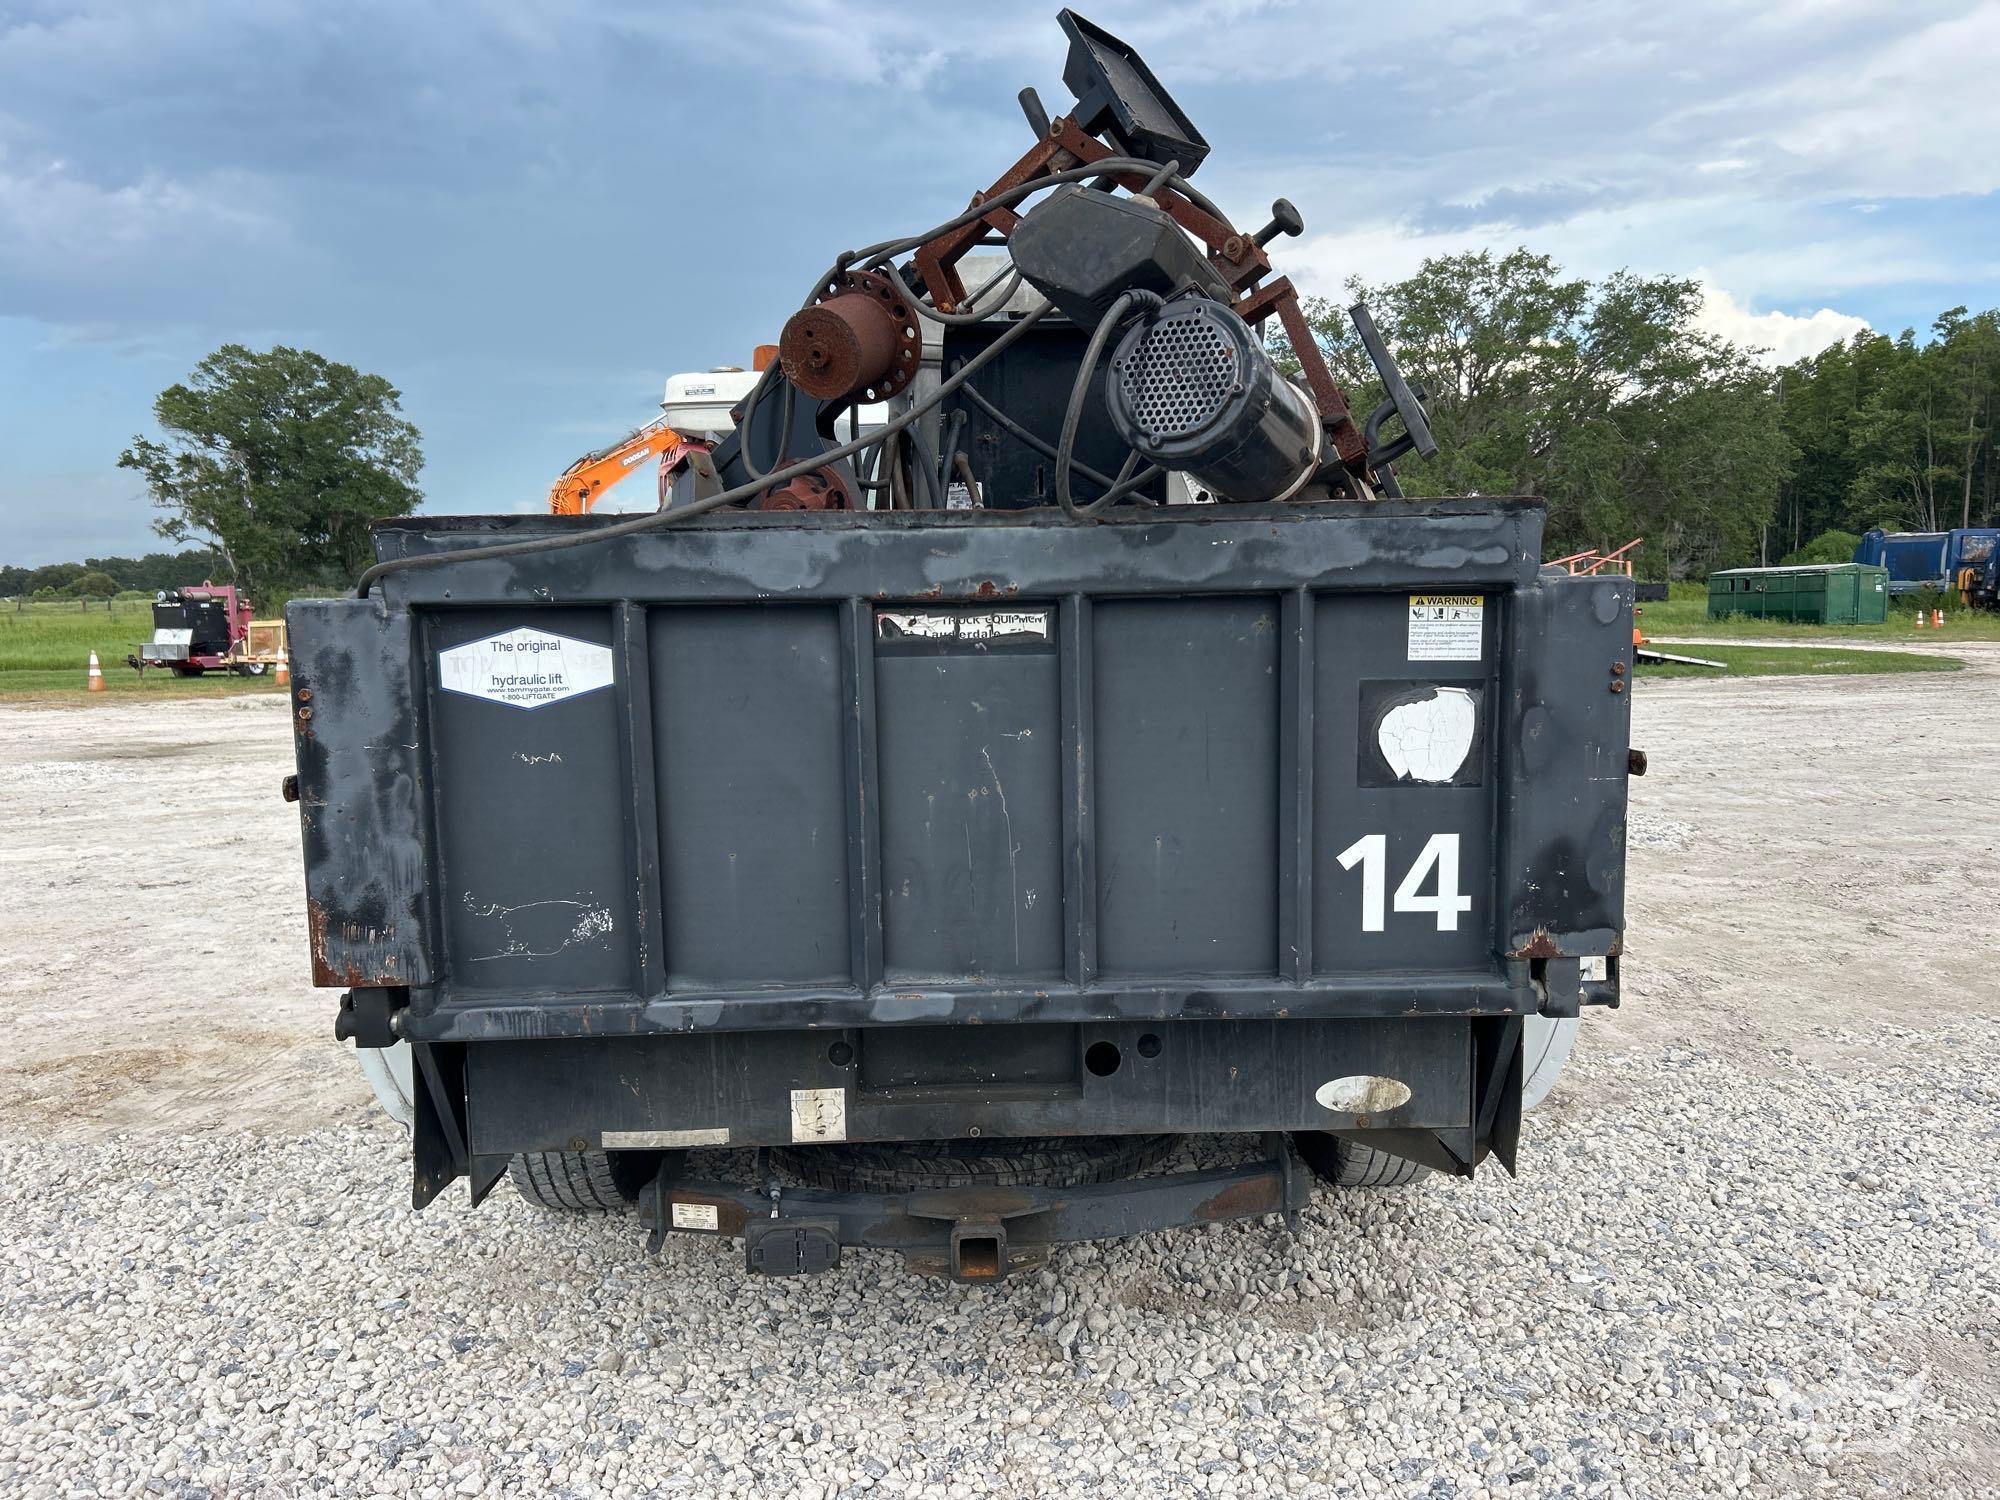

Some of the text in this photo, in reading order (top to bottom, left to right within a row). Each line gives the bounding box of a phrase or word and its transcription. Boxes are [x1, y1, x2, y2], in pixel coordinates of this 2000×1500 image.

[1427, 597, 1478, 605] WARNING
[490, 640, 561, 653] The original
[492, 674, 563, 688] hydraulic lift
[1336, 833, 1472, 932] 14
